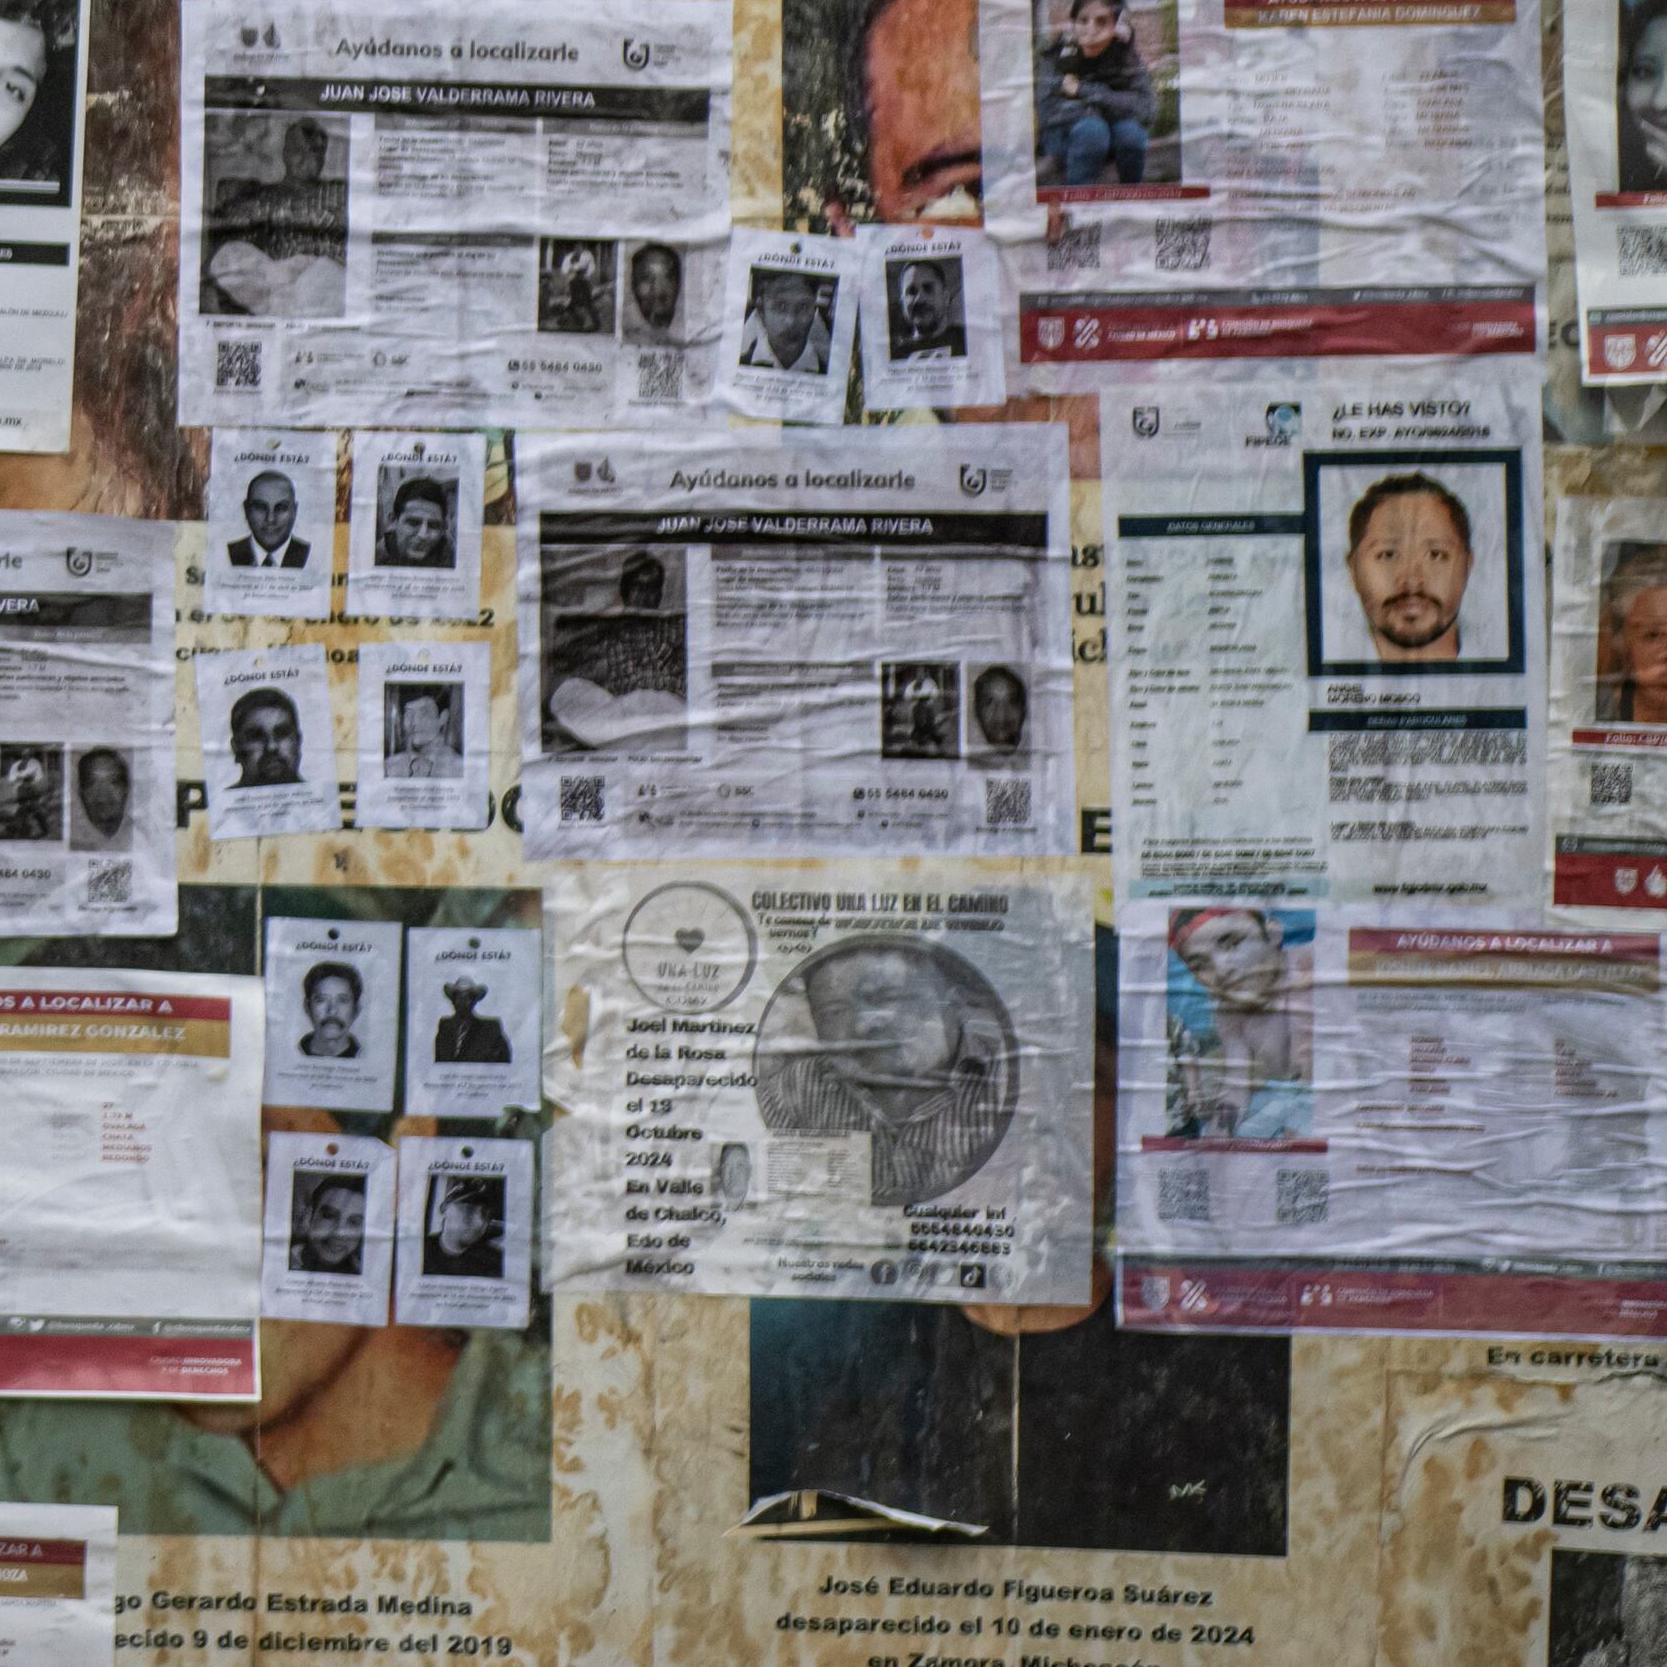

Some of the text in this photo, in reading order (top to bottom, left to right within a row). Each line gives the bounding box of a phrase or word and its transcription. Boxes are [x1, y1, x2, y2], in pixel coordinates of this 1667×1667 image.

[1314, 6, 1391, 22] ESTEFANIA
[1395, 4, 1481, 21] DOMINGUEZ
[335, 36, 579, 62] Ayúdanos a localizarle
[320, 84, 595, 108] JUAN JOSE VALDERRAMA RIVERA
[1333, 402, 1471, 419] ¿LE HAS VISTO?
[280, 452, 310, 464] ESTÁ?
[751, 892, 1009, 914] COLECTIVO UNA LUZ EN EL CAMINO
[1397, 930, 1612, 952] AYÚDANOS A LOCALIZAR A
[481, 949, 512, 961] ESTÁ?
[19, 993, 33, 1011] A
[39, 994, 152, 1013] LOCALIZAR
[158, 996, 173, 1013] A
[1, 1021, 80, 1039] RAMIREZ
[85, 1023, 186, 1041] GONZALEZ
[626, 1044, 726, 1061] de la Rosa
[626, 1071, 758, 1091] Desaparecido
[625, 1125, 703, 1141] Octubre
[625, 1151, 673, 1168] 2024
[625, 1178, 704, 1195] En Valle
[903, 1204, 981, 1221] Cualquier
[625, 1232, 691, 1250] Edo de
[625, 1258, 694, 1276] México
[1488, 1345, 1659, 1369] En carretera
[29, 1542, 42, 1557] A
[820, 1575, 1213, 1606] José Eduardo Figueroa Suárez
[150, 1590, 258, 1615] Gerardo
[266, 1593, 368, 1615] Estrada
[375, 1595, 473, 1618] Medina
[776, 1614, 1255, 1645] desaparecido el 10 de enero de 2024
[192, 1631, 208, 1652] 9
[216, 1631, 249, 1654] de
[257, 1628, 392, 1655] diciembre
[398, 1631, 440, 1655] del
[447, 1633, 513, 1656] 2019
